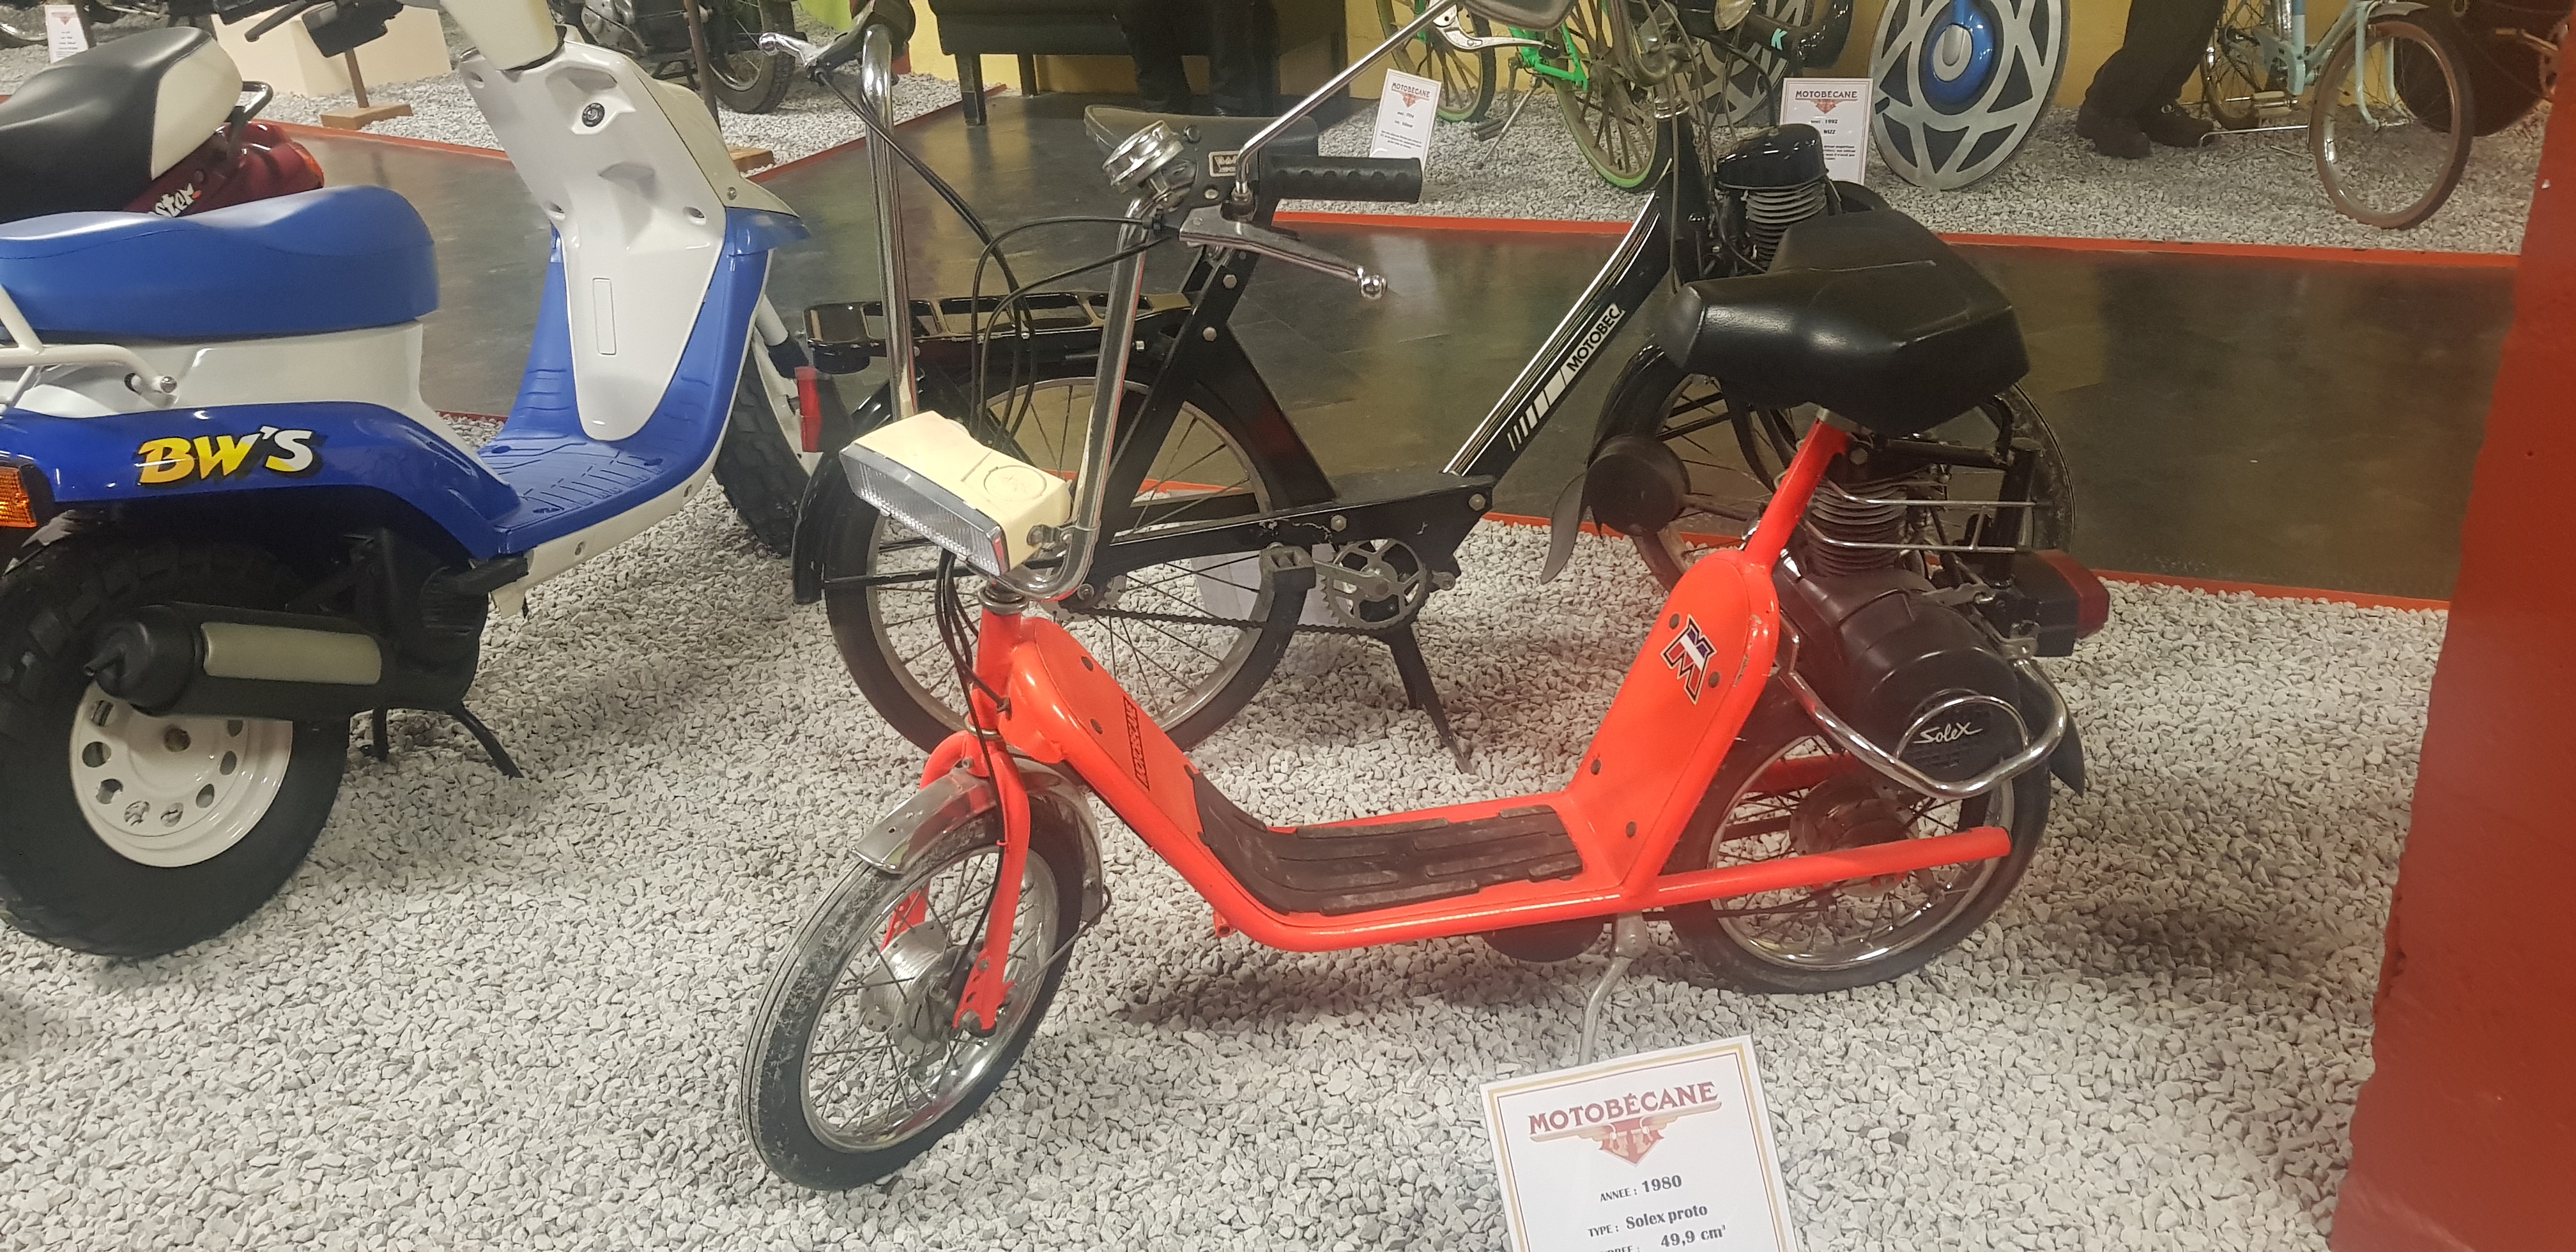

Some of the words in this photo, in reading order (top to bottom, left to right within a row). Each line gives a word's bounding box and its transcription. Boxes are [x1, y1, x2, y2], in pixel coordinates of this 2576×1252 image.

[1528, 1081, 1719, 1134] MOTOBÉCANE
[1600, 1187, 1632, 1202] ANNEE
[1641, 1175, 1683, 1193] 1980
[1588, 1225, 1613, 1237] TYPE
[1625, 1212, 1666, 1230] Solex
[1668, 1205, 1708, 1224] proto
[1660, 1230, 1695, 1248] 49,9
